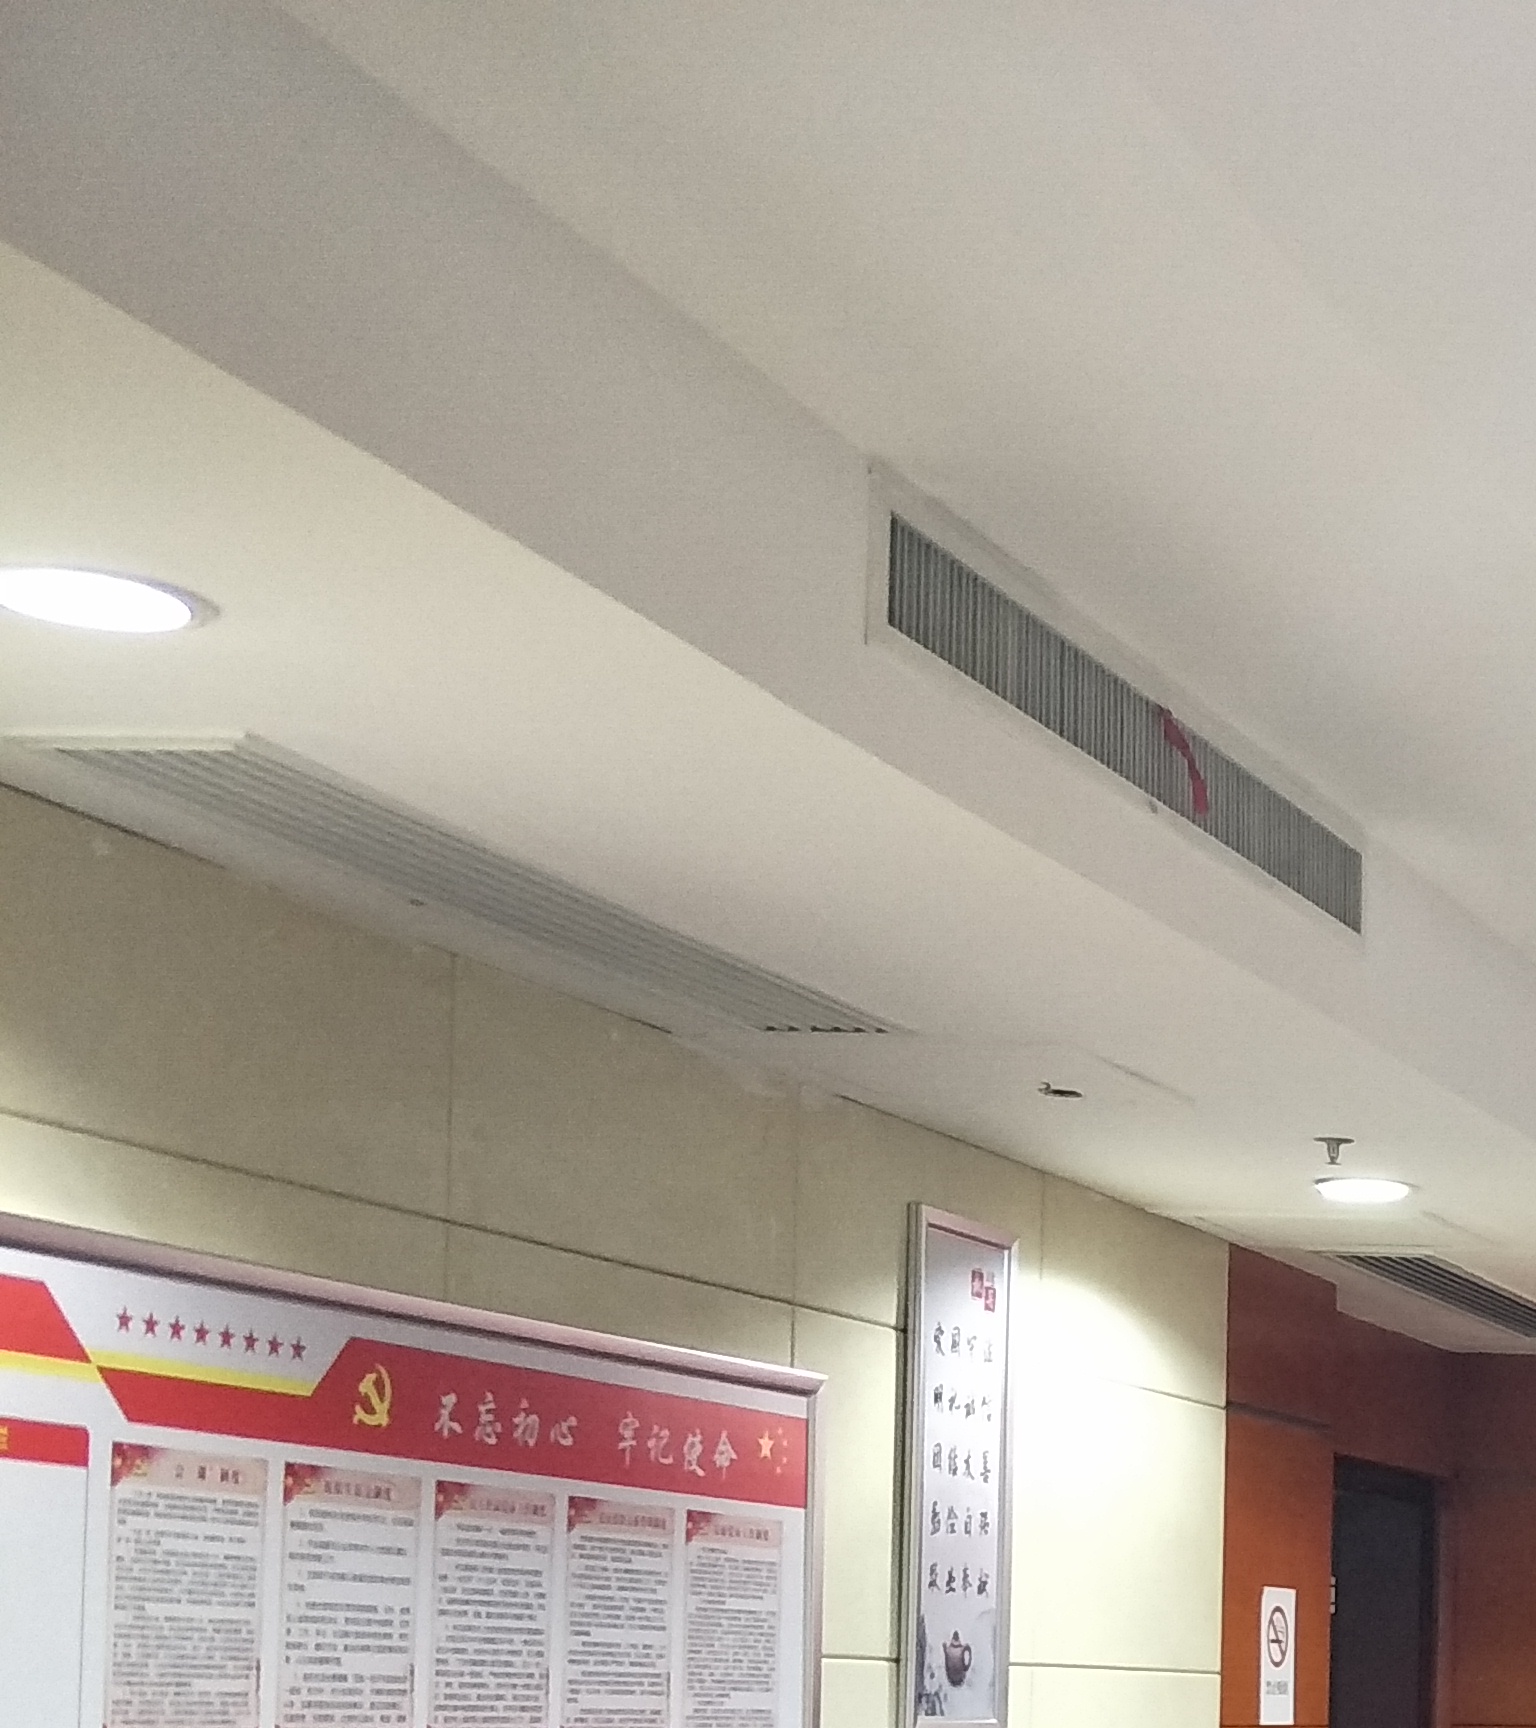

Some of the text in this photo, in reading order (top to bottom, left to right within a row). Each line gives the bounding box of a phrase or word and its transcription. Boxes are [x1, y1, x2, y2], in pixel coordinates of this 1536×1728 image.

[433, 1390, 739, 1480] 不忘初心 牢记使命
